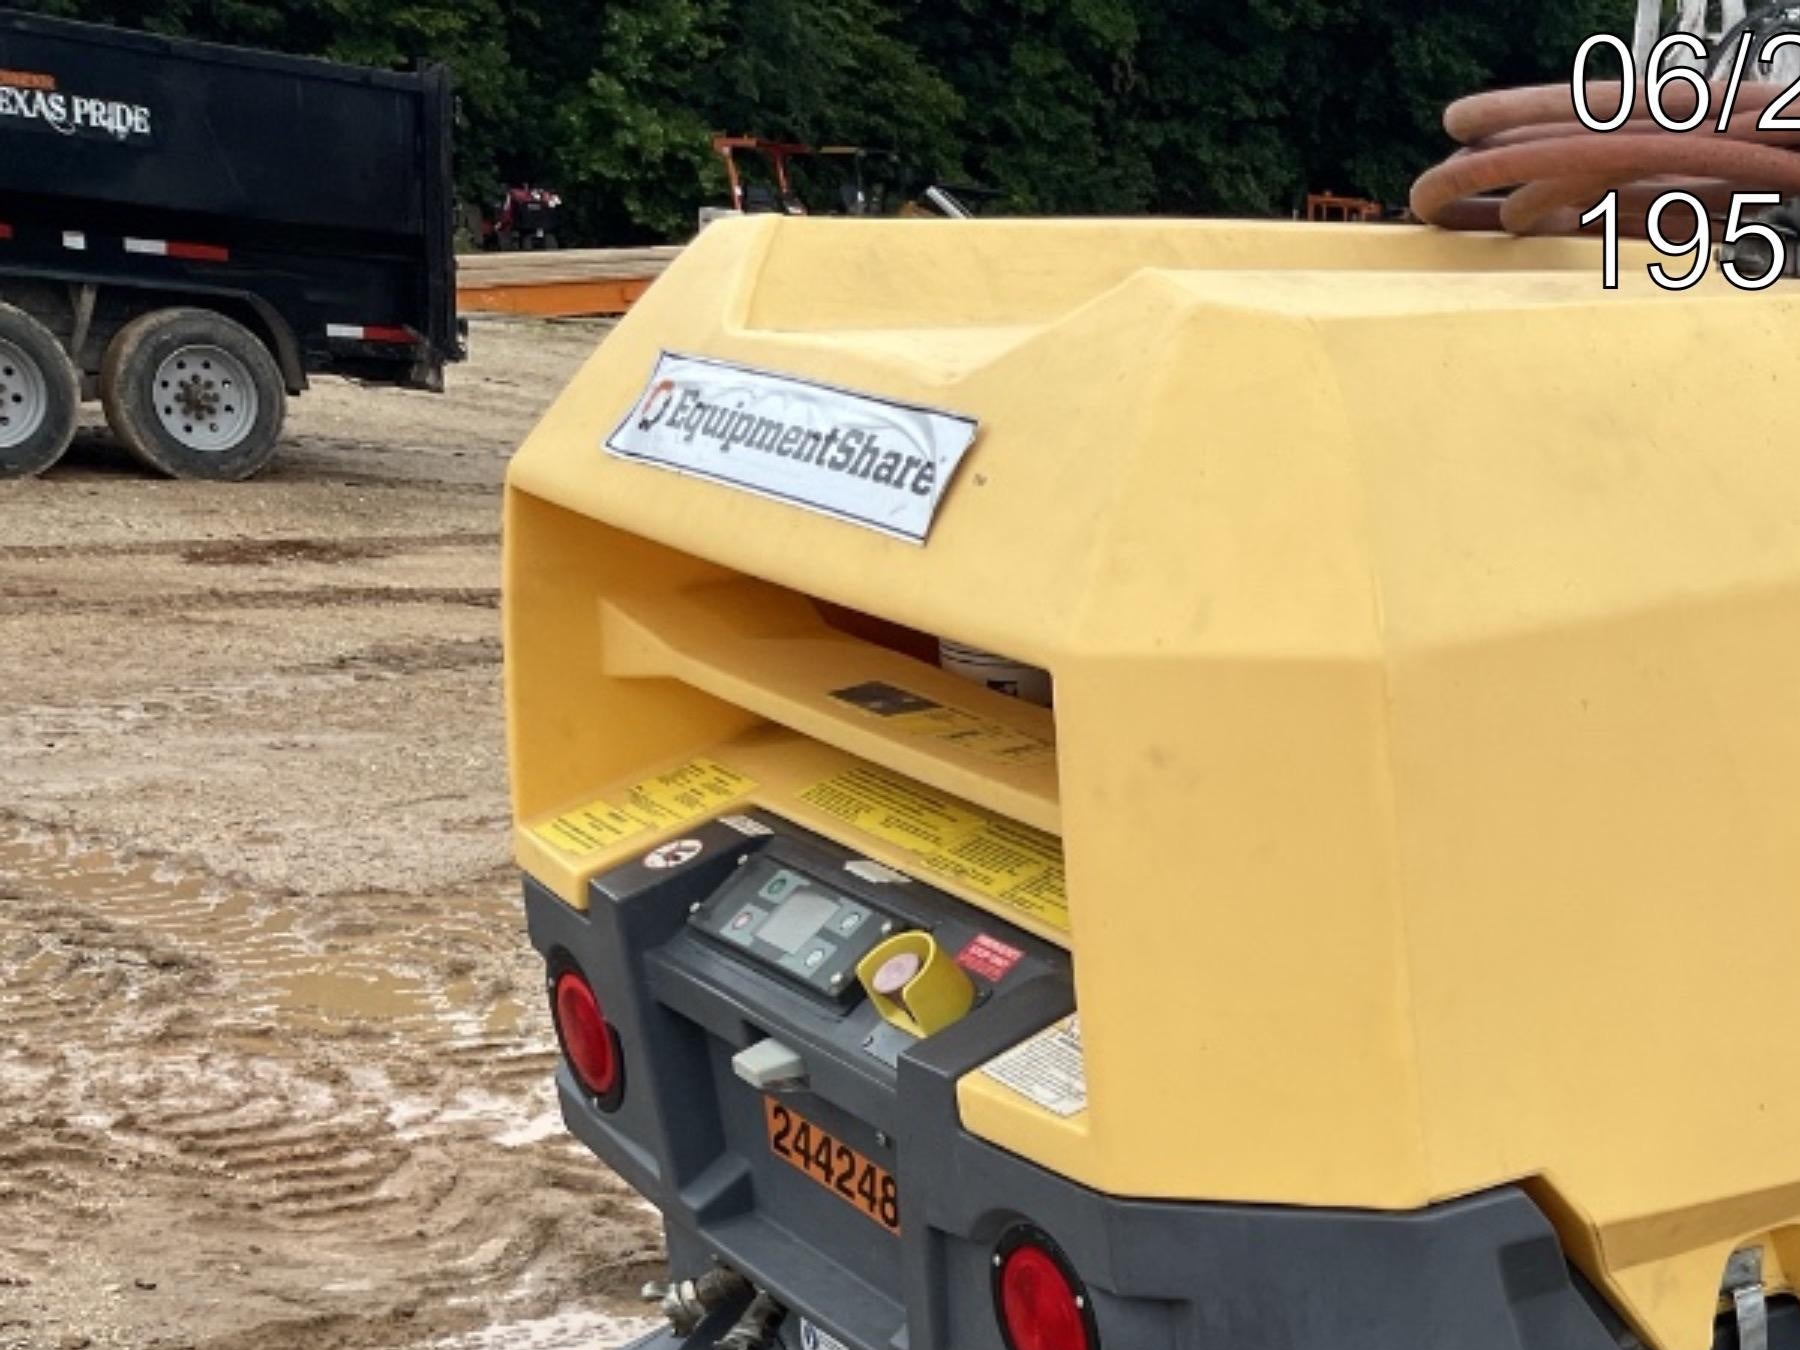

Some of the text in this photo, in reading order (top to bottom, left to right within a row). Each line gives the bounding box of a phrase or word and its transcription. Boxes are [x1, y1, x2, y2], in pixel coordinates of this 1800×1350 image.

[72, 95, 151, 138] PRIDE
[667, 389, 936, 497] EquipmentShare
[772, 1104, 899, 1228] 244248
